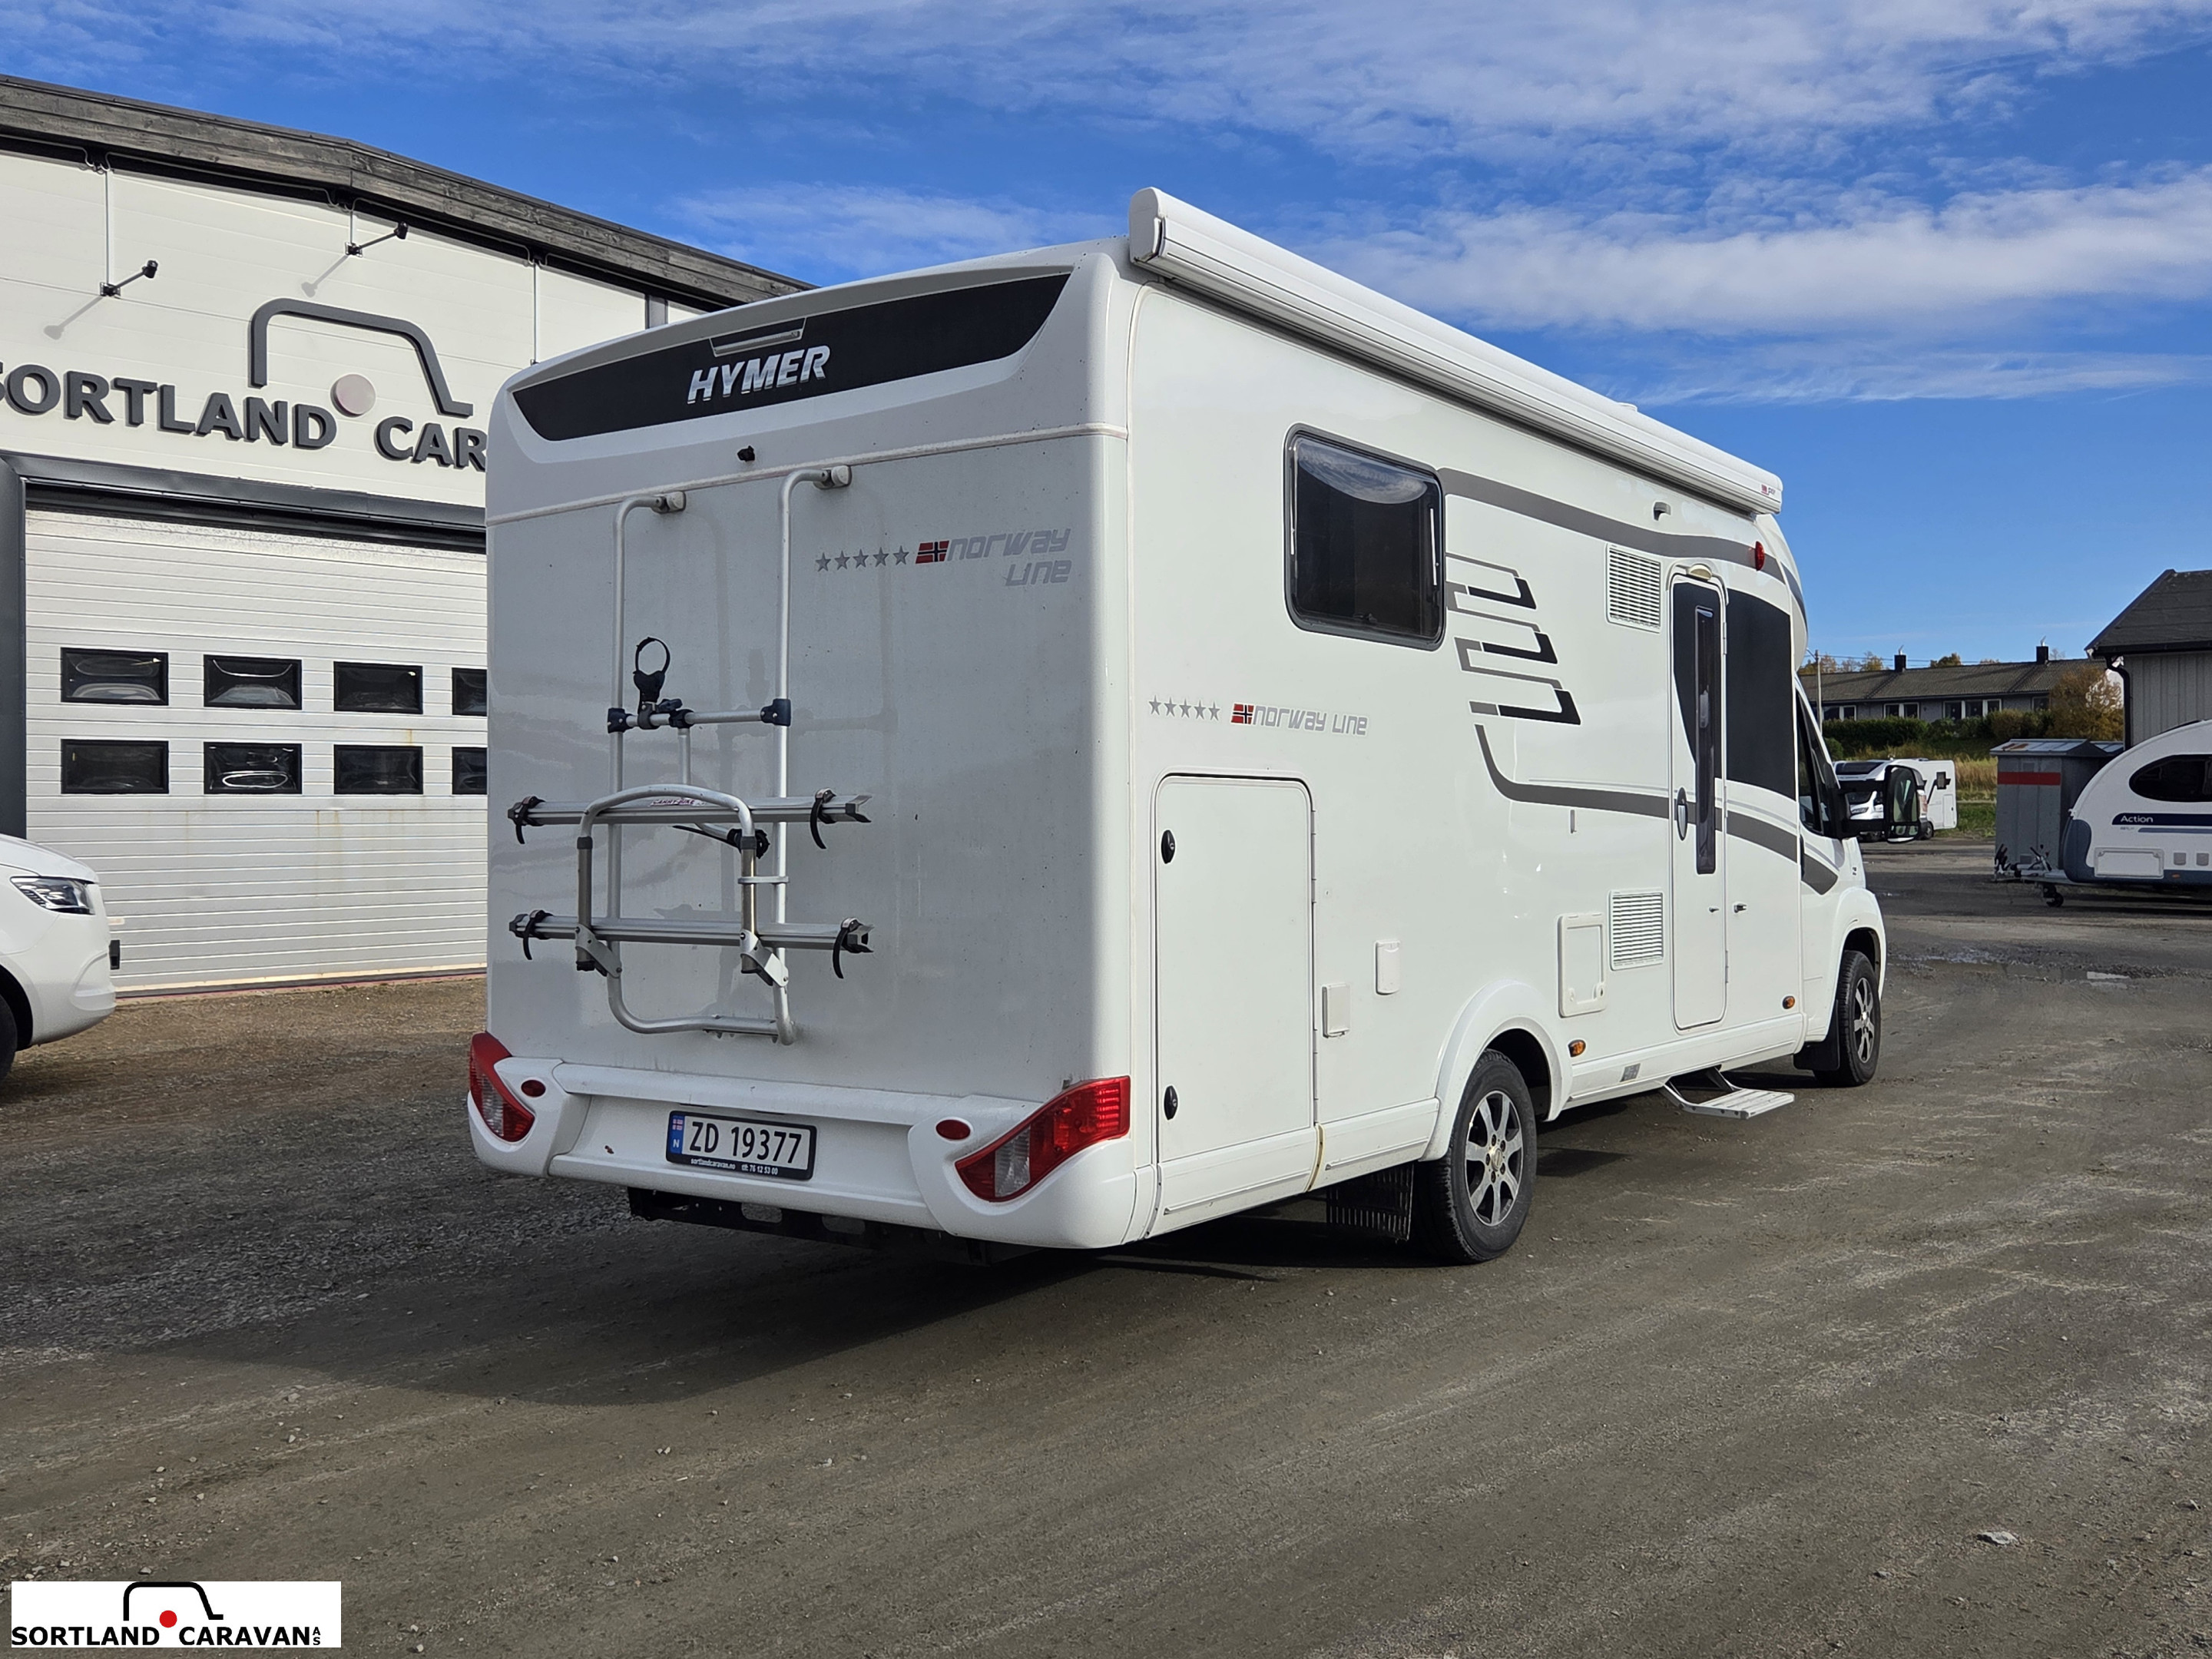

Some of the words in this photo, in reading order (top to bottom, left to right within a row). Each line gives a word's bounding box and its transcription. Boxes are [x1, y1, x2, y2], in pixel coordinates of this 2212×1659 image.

[687, 345, 831, 405] HYMER
[0, 362, 338, 450] ORTLAND
[2120, 815, 2154, 823] Action
[673, 1138, 680, 1148] N
[689, 1121, 720, 1154] ZD
[730, 1126, 802, 1164] 19377
[757, 1165, 763, 1174] 12
